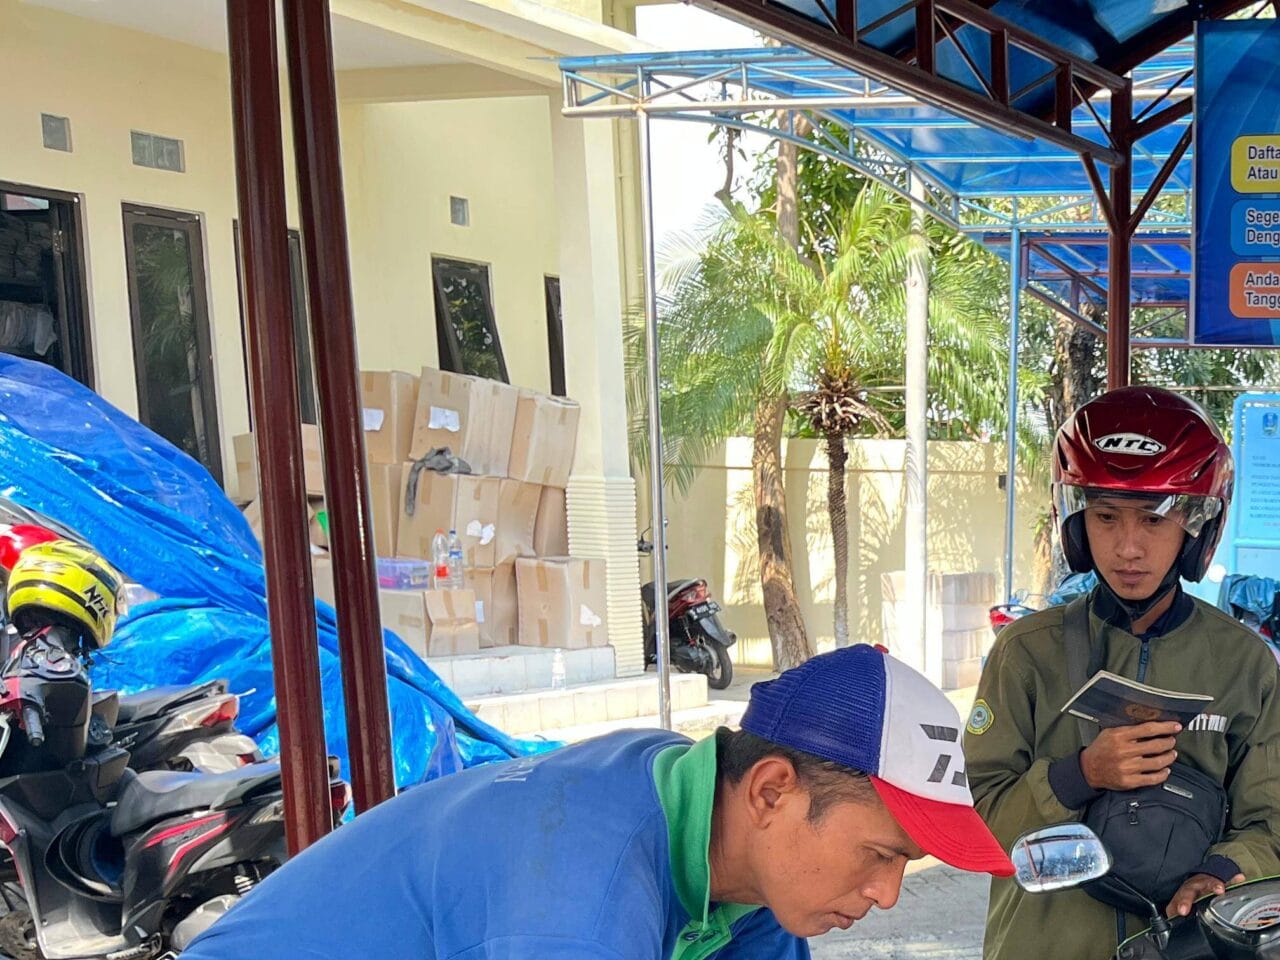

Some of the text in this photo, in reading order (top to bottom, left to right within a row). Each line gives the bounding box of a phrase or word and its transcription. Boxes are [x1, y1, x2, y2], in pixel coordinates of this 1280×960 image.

[1247, 166, 1278, 180] Atau
[1245, 273, 1280, 286] Anda
[1103, 437, 1157, 451] NTC
